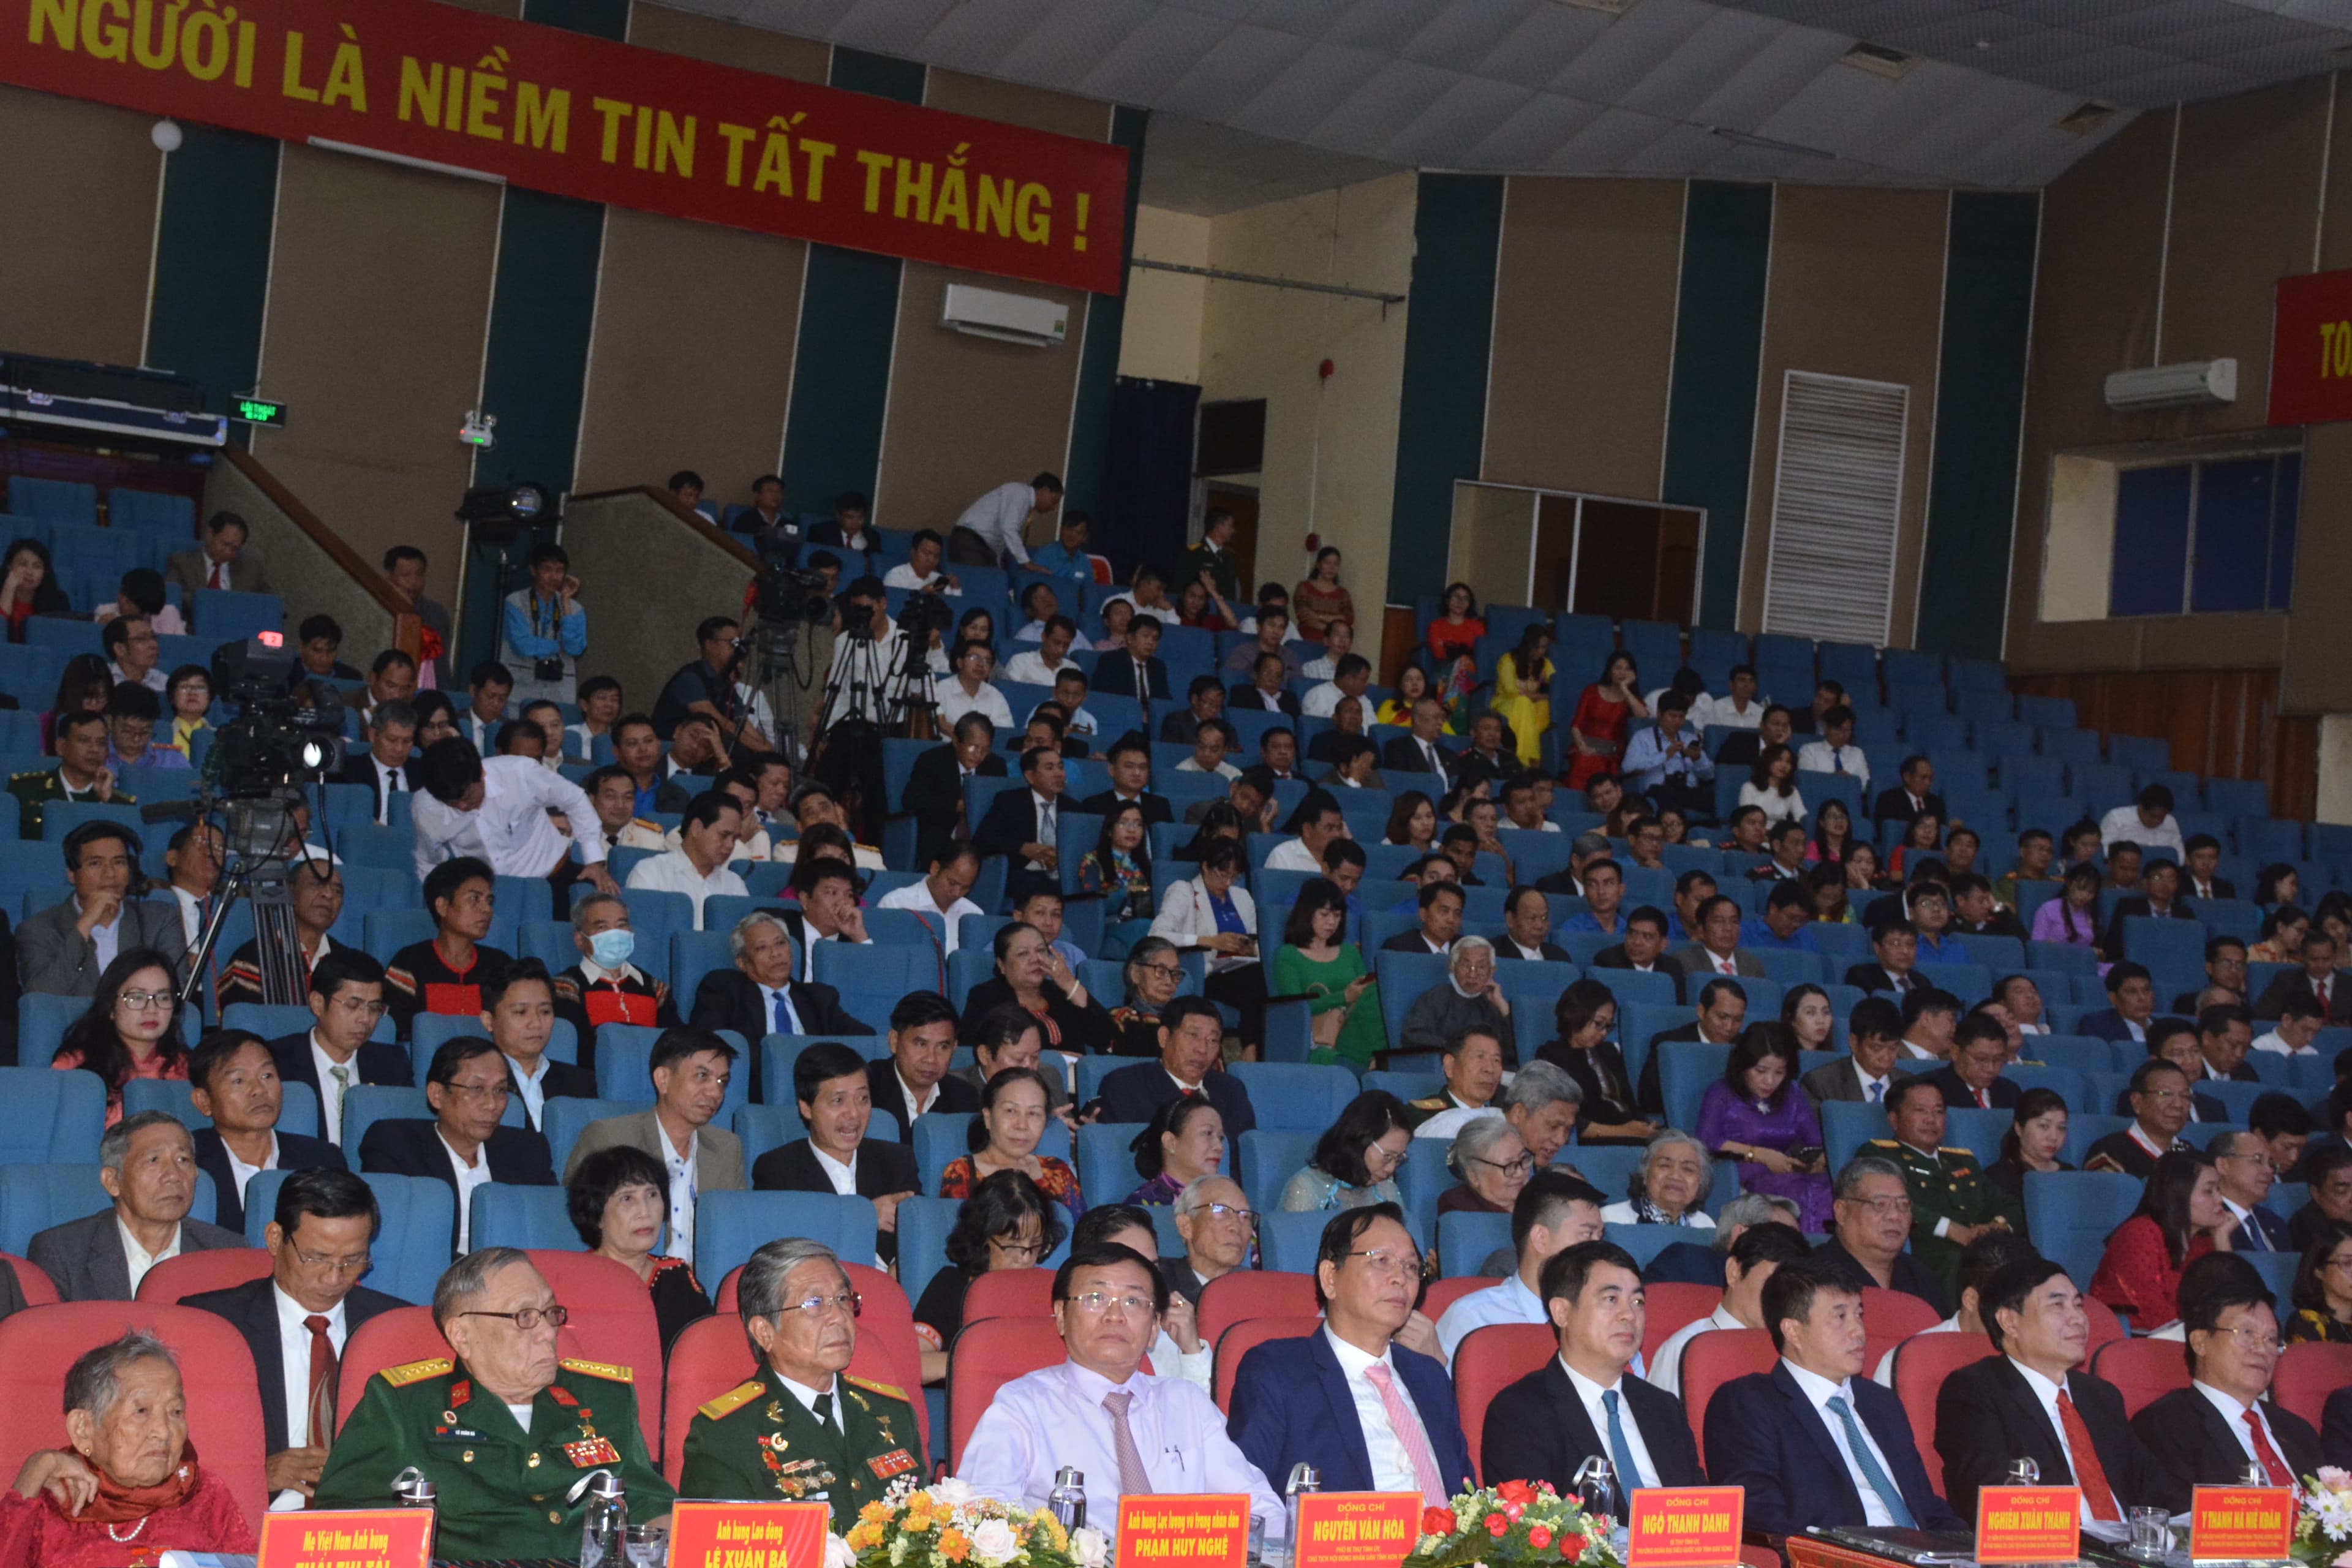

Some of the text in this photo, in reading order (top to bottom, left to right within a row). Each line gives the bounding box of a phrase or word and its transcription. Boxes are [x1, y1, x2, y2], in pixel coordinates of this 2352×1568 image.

[29, 0, 1090, 252] NGƯỜI LÀ NIỀM TIN TẤT THẮNG !
[2320, 320, 2352, 379] TO
[1337, 1502, 1385, 1512] ĐỒNG CHÍ
[1666, 1496, 1709, 1507] ĐỒNG CHÍ
[716, 1519, 783, 1545] Anh hùng Lao động
[1313, 1512, 1356, 1542] NGUYỄN
[1359, 1517, 1381, 1540] VĂN
[1642, 1510, 1730, 1534] NGÔ THANH DANH
[303, 1528, 388, 1556] Mẹ Việt Nam Anh hùng
[1136, 1533, 1229, 1561] PHẠM HUY NGHỆ
[705, 1545, 788, 1568] LÊ XUÂN BÁ
